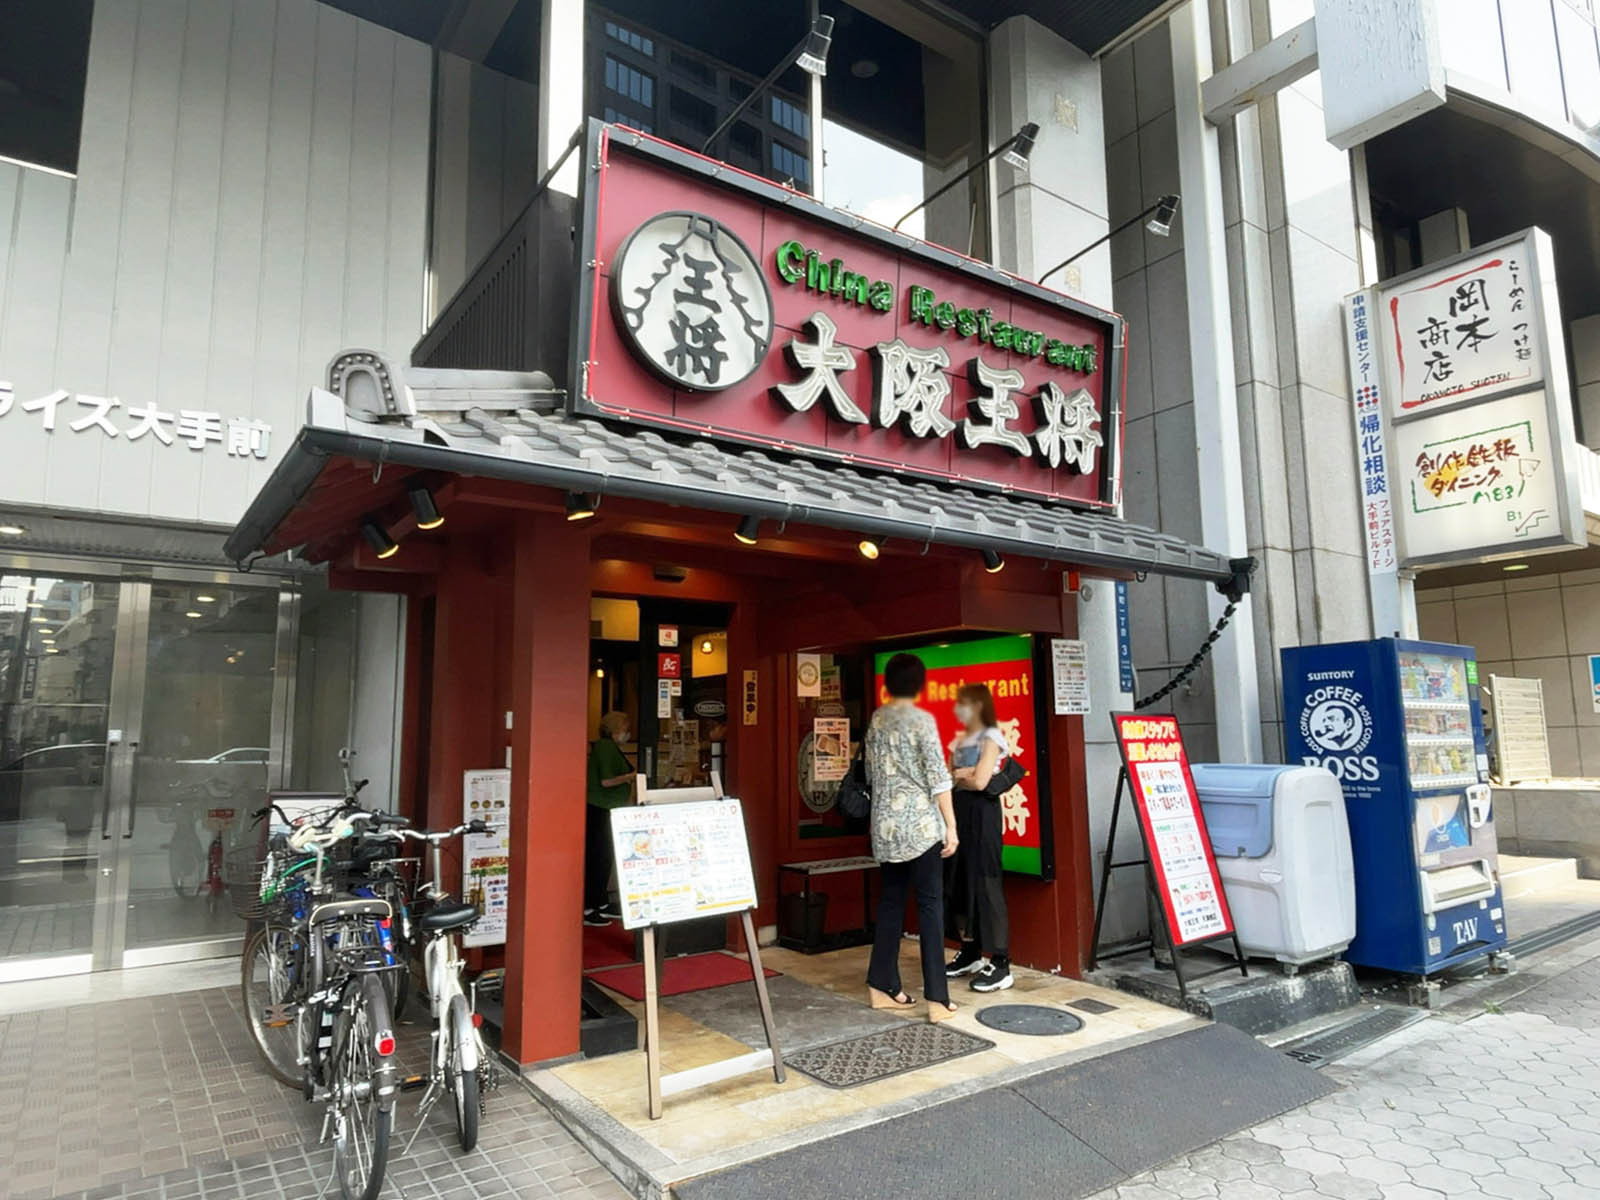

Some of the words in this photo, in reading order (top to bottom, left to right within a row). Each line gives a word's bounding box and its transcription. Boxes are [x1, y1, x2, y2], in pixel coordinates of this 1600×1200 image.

[1509, 260, 1525, 313] らーめん
[664, 252, 729, 384] 王将
[776, 240, 894, 312] China
[909, 285, 1098, 375] Restaurant
[1449, 278, 1500, 354] 岡本
[1417, 316, 1454, 385] 商店
[769, 312, 1104, 476] 大阪王将
[1359, 413, 1387, 497] 帰化相談
[1415, 437, 1520, 478] 創作鉄板
[1430, 465, 1502, 498] ダイニング
[1379, 499, 1394, 568] フェアステージ
[1506, 510, 1523, 522] B1
[1305, 685, 1363, 707] COFFEE
[1307, 670, 1355, 682] SUNTORY
[1300, 707, 1312, 737] COFFEE
[1358, 704, 1373, 727] BOSS
[1305, 737, 1325, 755] BOSS
[1352, 727, 1373, 755] COFFEE
